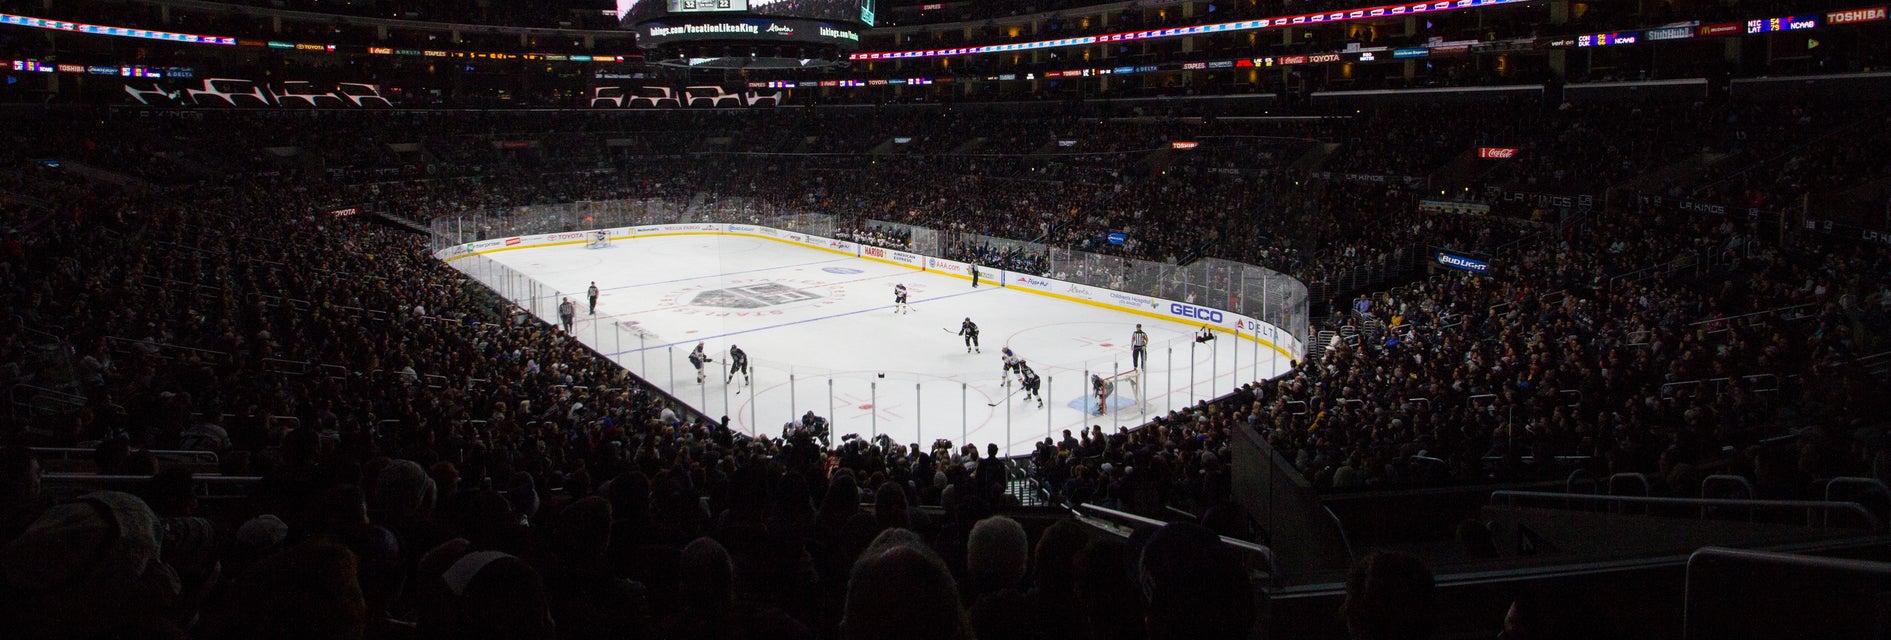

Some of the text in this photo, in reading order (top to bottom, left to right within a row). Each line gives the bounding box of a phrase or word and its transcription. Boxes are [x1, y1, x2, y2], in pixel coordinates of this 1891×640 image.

[1827, 9, 1886, 22] TOSHIBA
[1309, 54, 1340, 63] TOYOTA
[58, 64, 85, 73] TOSHIBA
[864, 246, 884, 258] HARIBO
[936, 260, 961, 271] AAA.com
[1442, 255, 1487, 270] BUD LIGHT
[1171, 303, 1223, 323] GEICO
